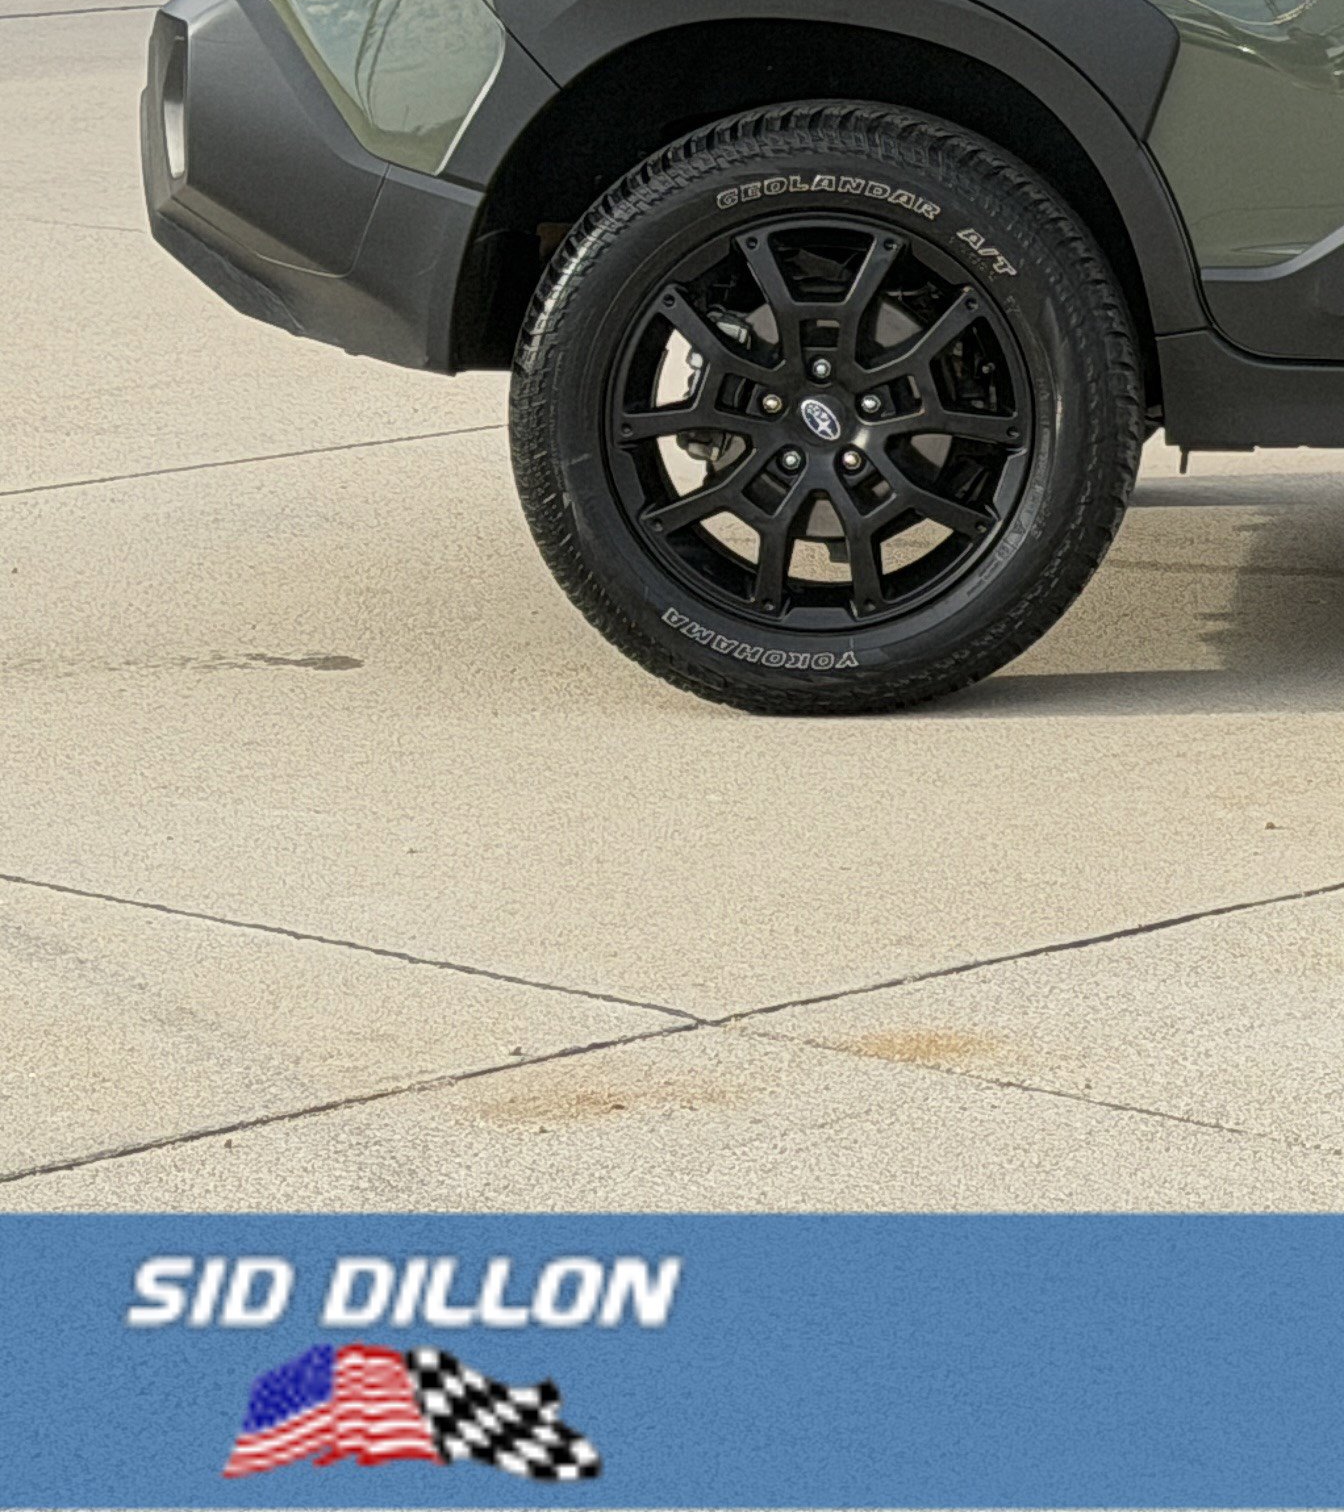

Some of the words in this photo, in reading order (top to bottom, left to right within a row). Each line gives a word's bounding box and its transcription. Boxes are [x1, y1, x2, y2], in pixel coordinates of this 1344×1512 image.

[716, 174, 941, 221] GEOLANDAR
[956, 228, 1017, 276] A/T
[661, 606, 860, 671] YOKOHAMA
